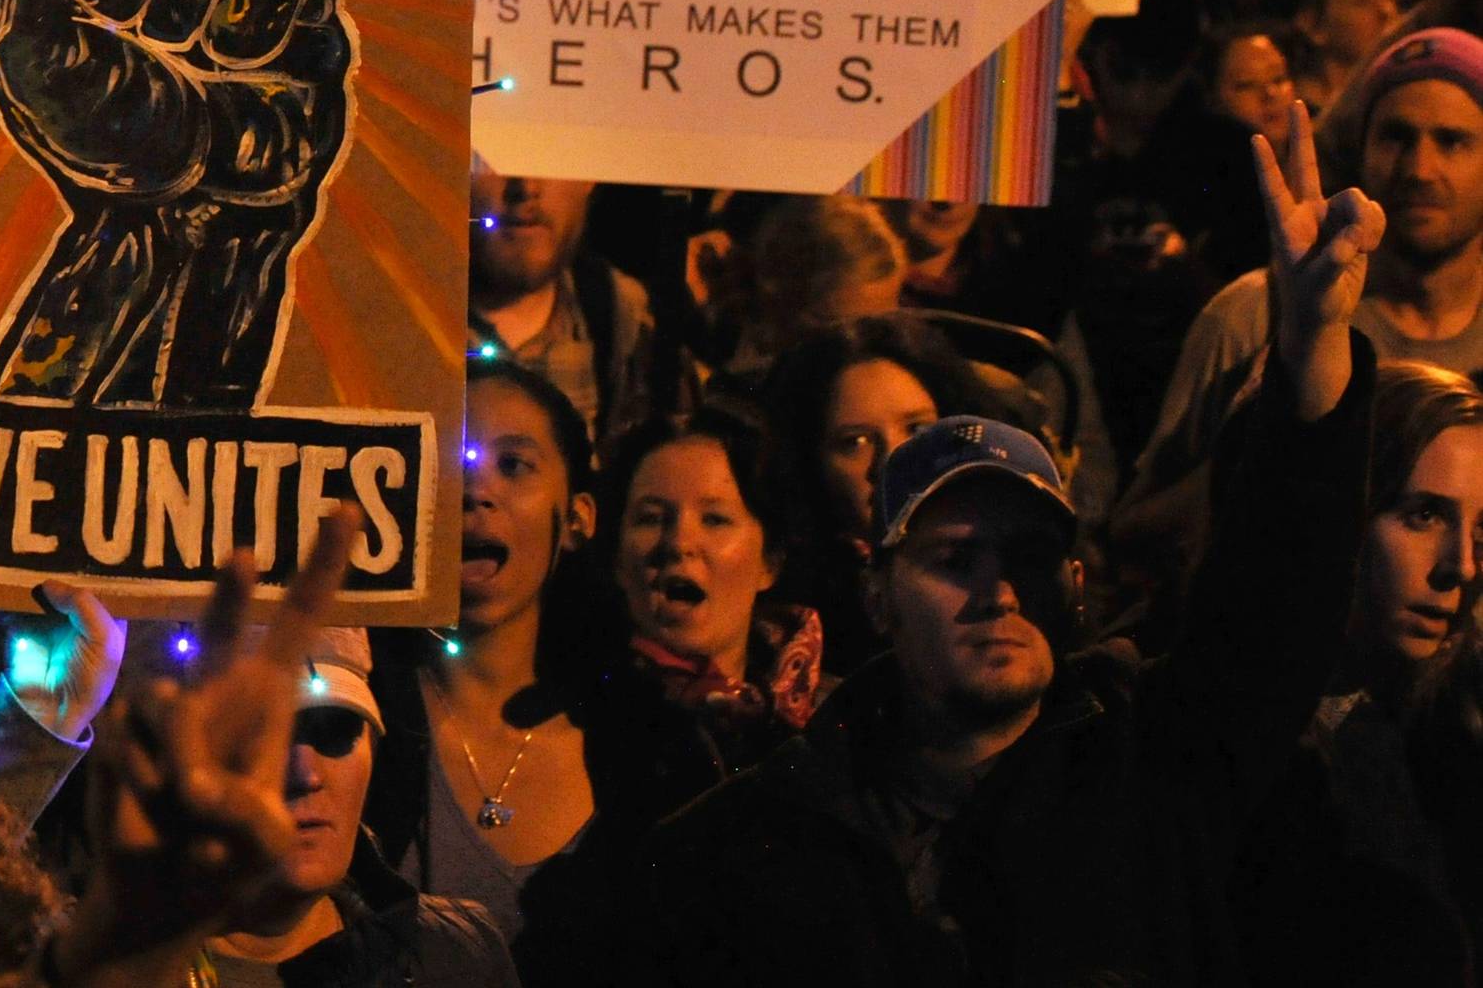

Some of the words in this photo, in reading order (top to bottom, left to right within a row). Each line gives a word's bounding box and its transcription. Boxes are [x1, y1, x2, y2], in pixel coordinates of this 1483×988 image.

[686, 3, 823, 40] MAKES
[852, 13, 961, 47] THEM
[81, 434, 406, 574] UNITES
